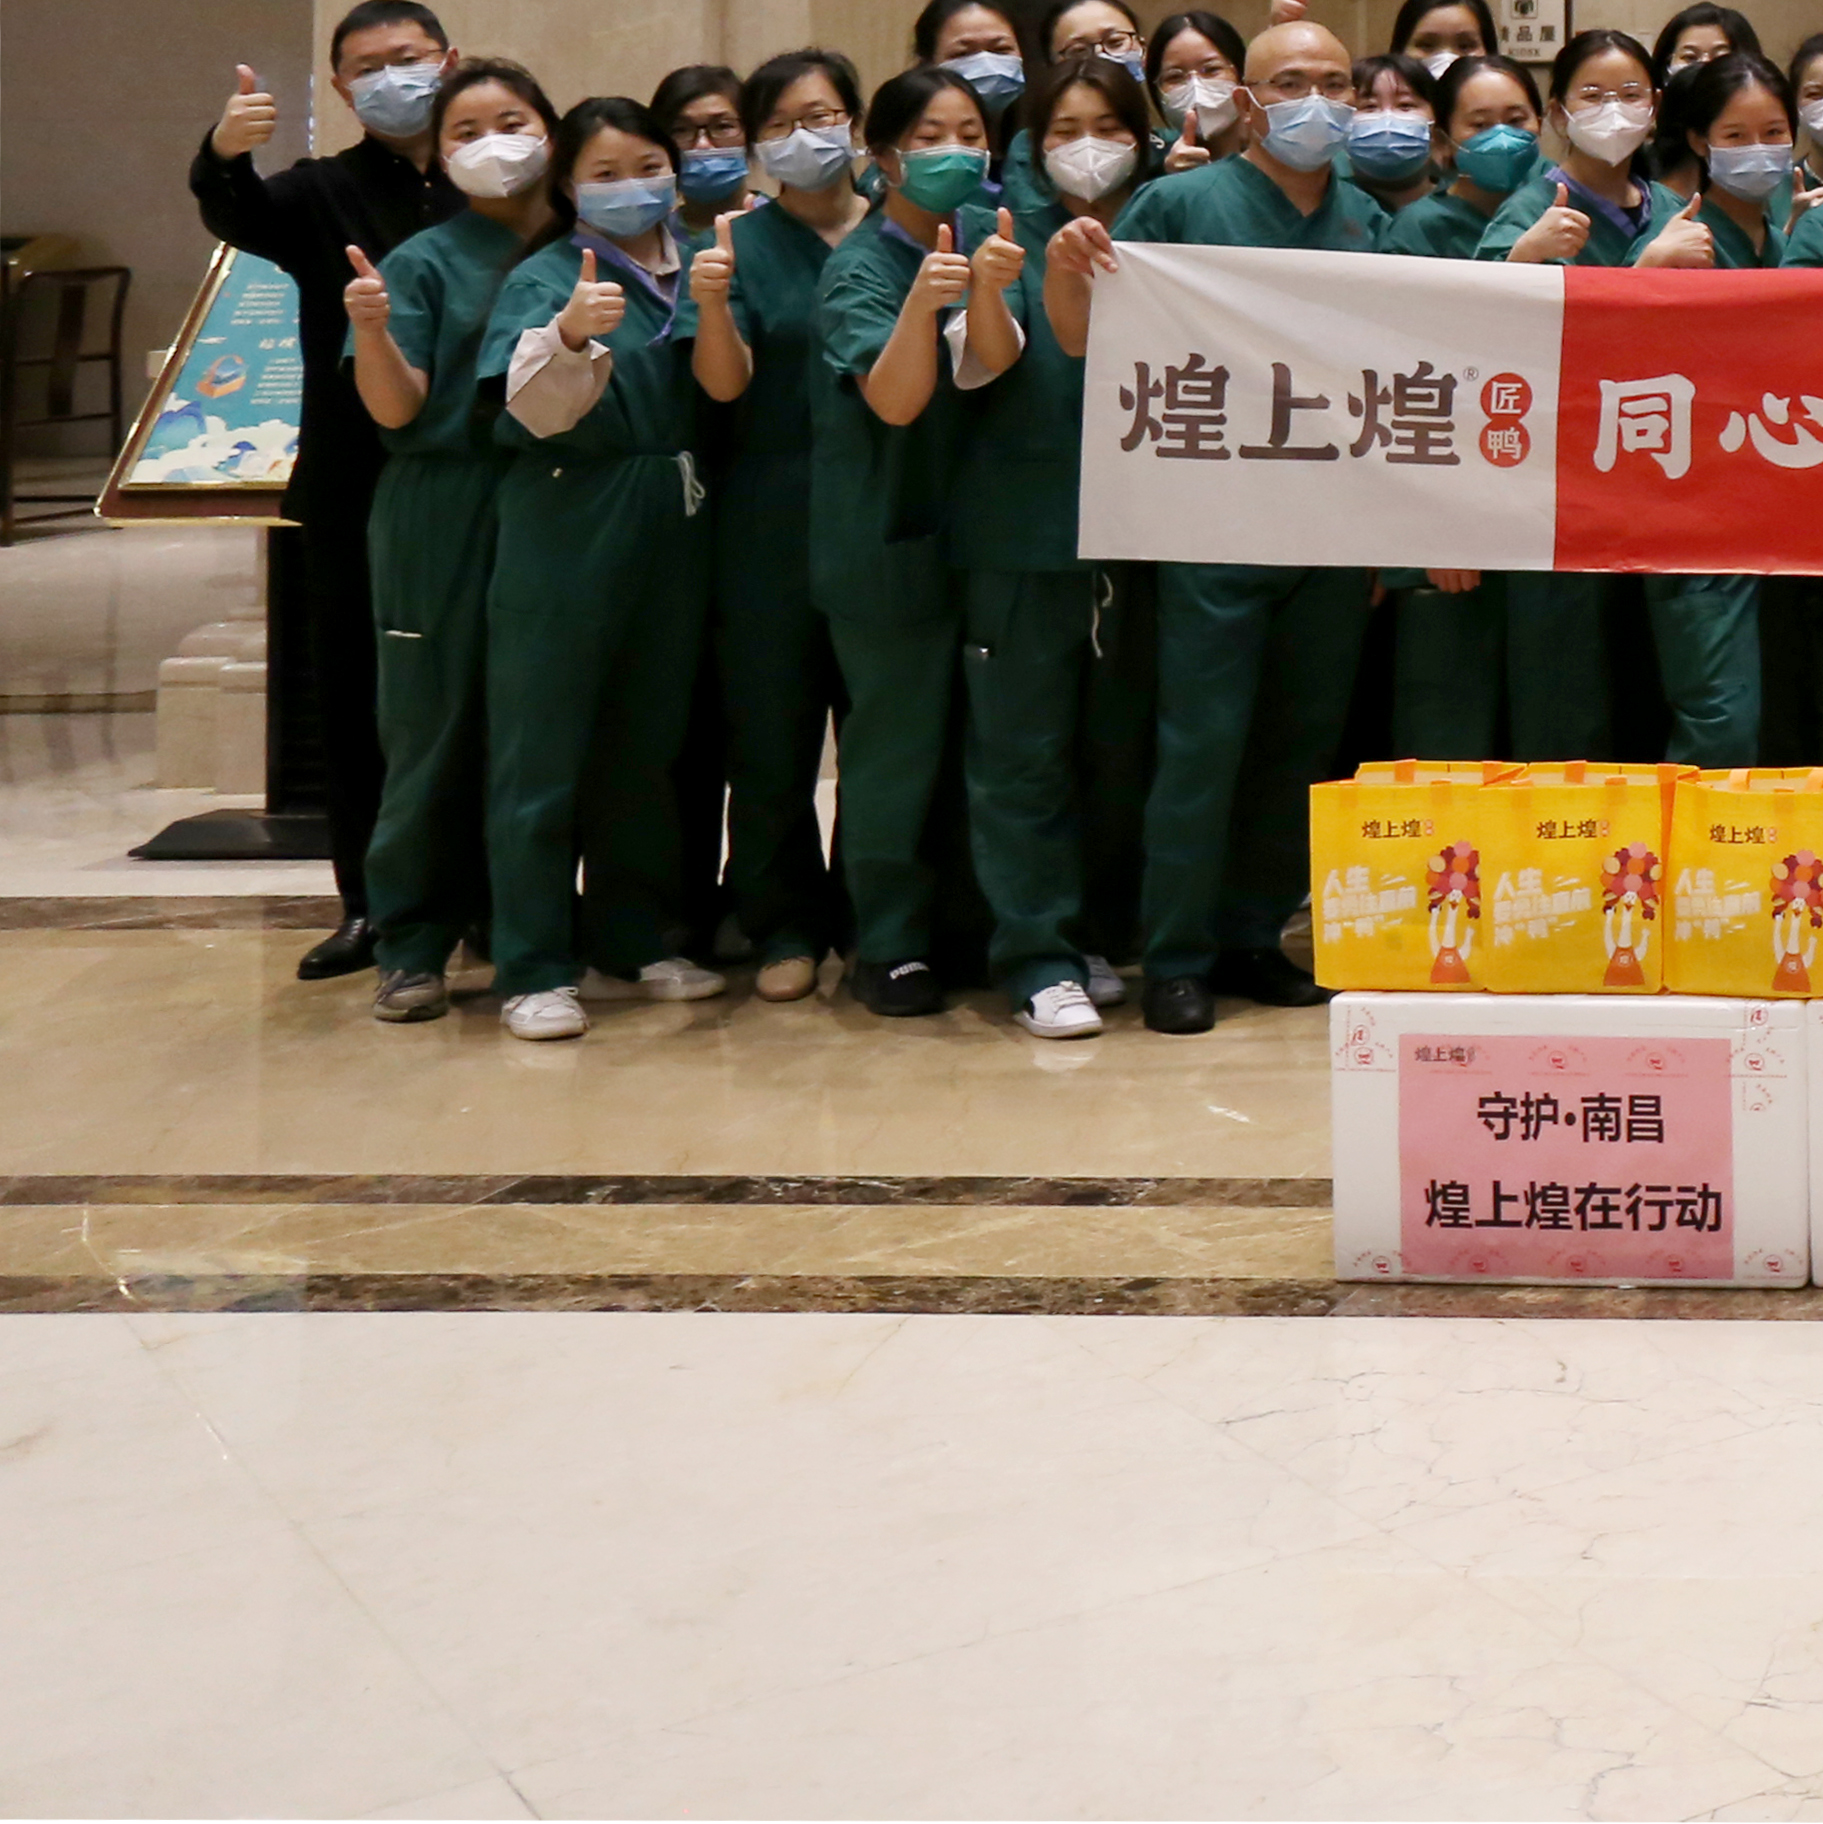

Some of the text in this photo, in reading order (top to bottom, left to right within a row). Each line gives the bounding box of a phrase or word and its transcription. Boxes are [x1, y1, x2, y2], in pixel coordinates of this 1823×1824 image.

[1119, 352, 1461, 466] 煌上煌
[1486, 380, 1523, 460] 匠鸭
[1361, 818, 1422, 840] 煌上煌
[1536, 819, 1598, 840] 煌上煌
[1709, 824, 1766, 844] 煌上煌
[1477, 1091, 1665, 1144] 守护·南昌
[1424, 1179, 1723, 1233] 煌上煌在行动
